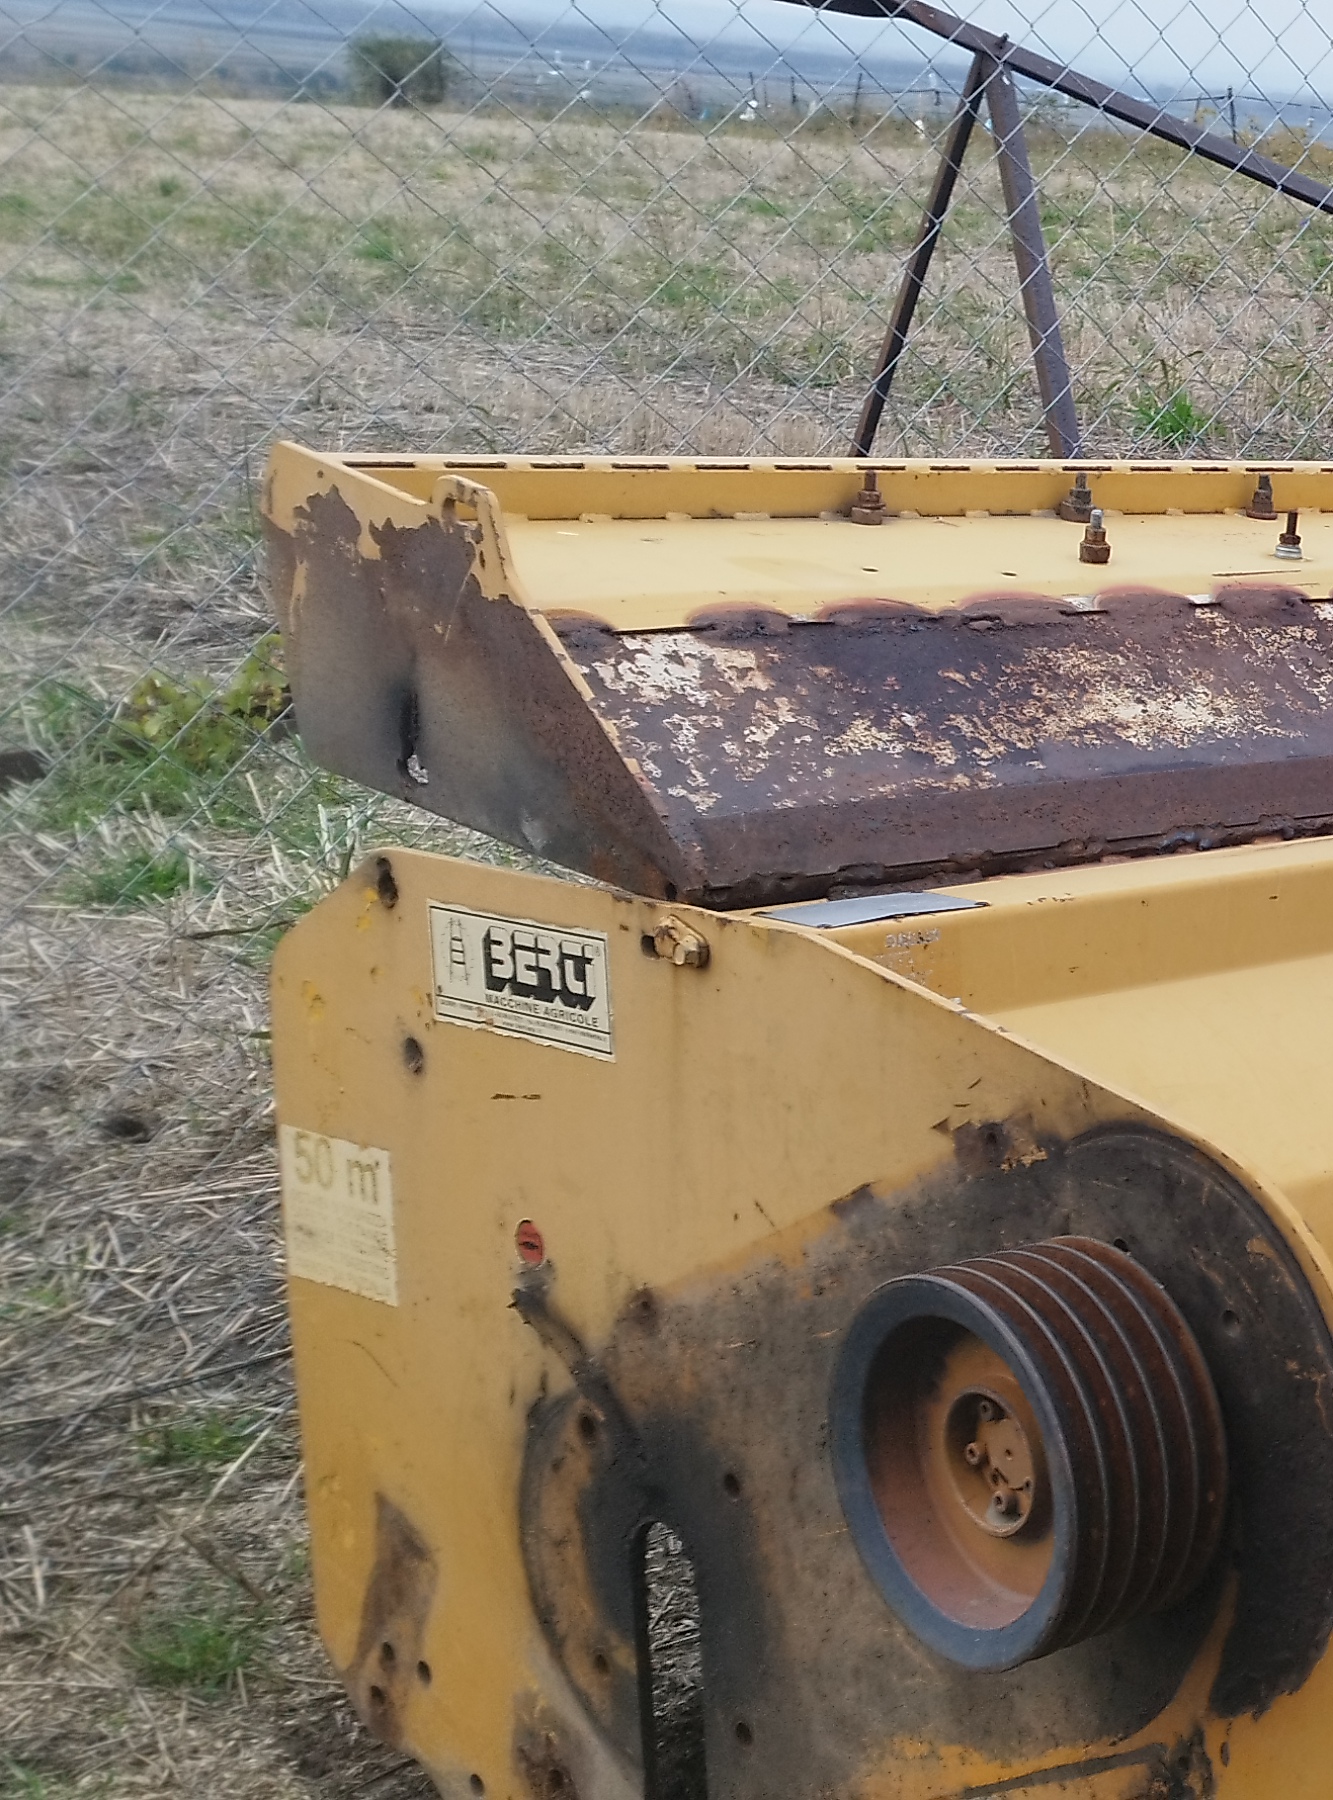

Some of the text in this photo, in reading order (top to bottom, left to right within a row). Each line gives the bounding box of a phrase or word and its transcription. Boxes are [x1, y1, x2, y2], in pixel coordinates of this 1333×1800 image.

[485, 993, 540, 1015] MACCHINE
[543, 1006, 600, 1028] AGRICOLE
[294, 1131, 333, 1190] 50
